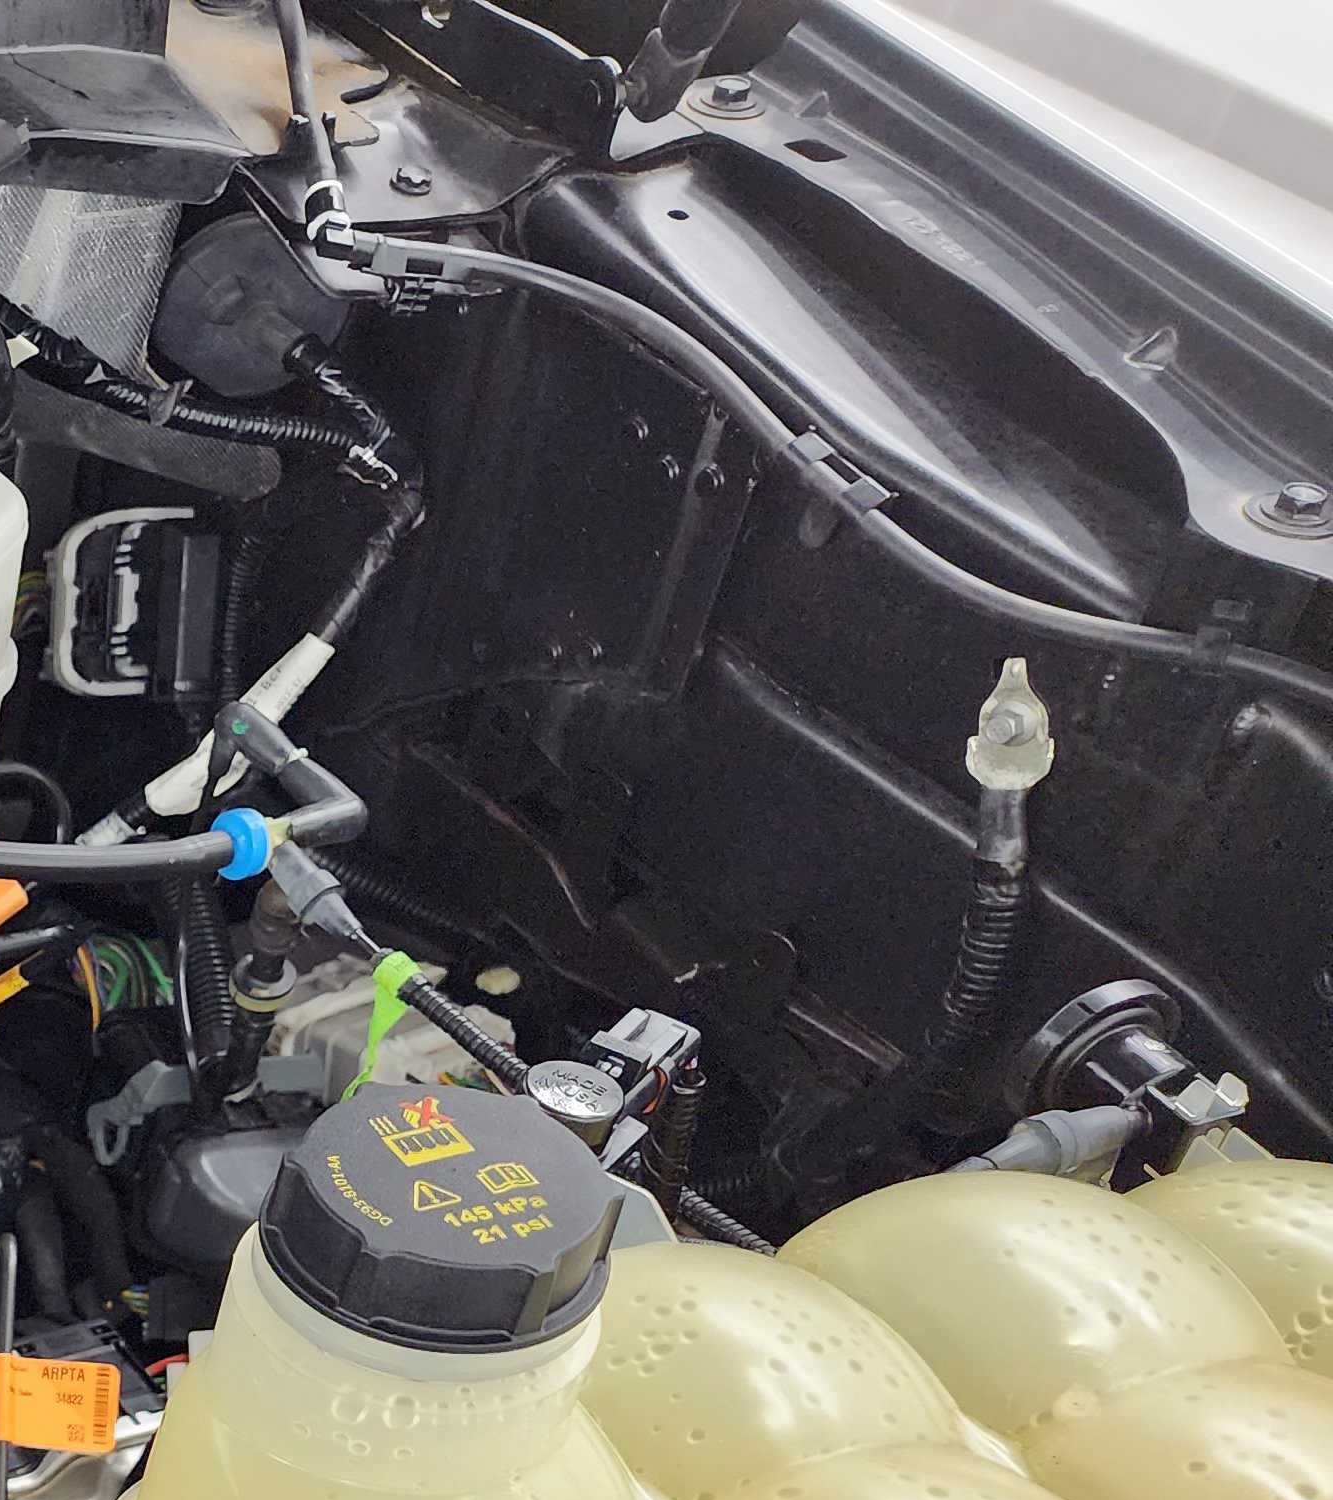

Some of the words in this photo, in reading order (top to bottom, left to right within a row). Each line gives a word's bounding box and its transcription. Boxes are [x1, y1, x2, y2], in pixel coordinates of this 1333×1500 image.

[551, 1069, 608, 1097] MADE
[443, 1204, 494, 1229] 145
[492, 1195, 548, 1217] kPa
[471, 1223, 509, 1245] 21
[511, 1213, 555, 1239] psi
[41, 1365, 86, 1382] ARPTA
